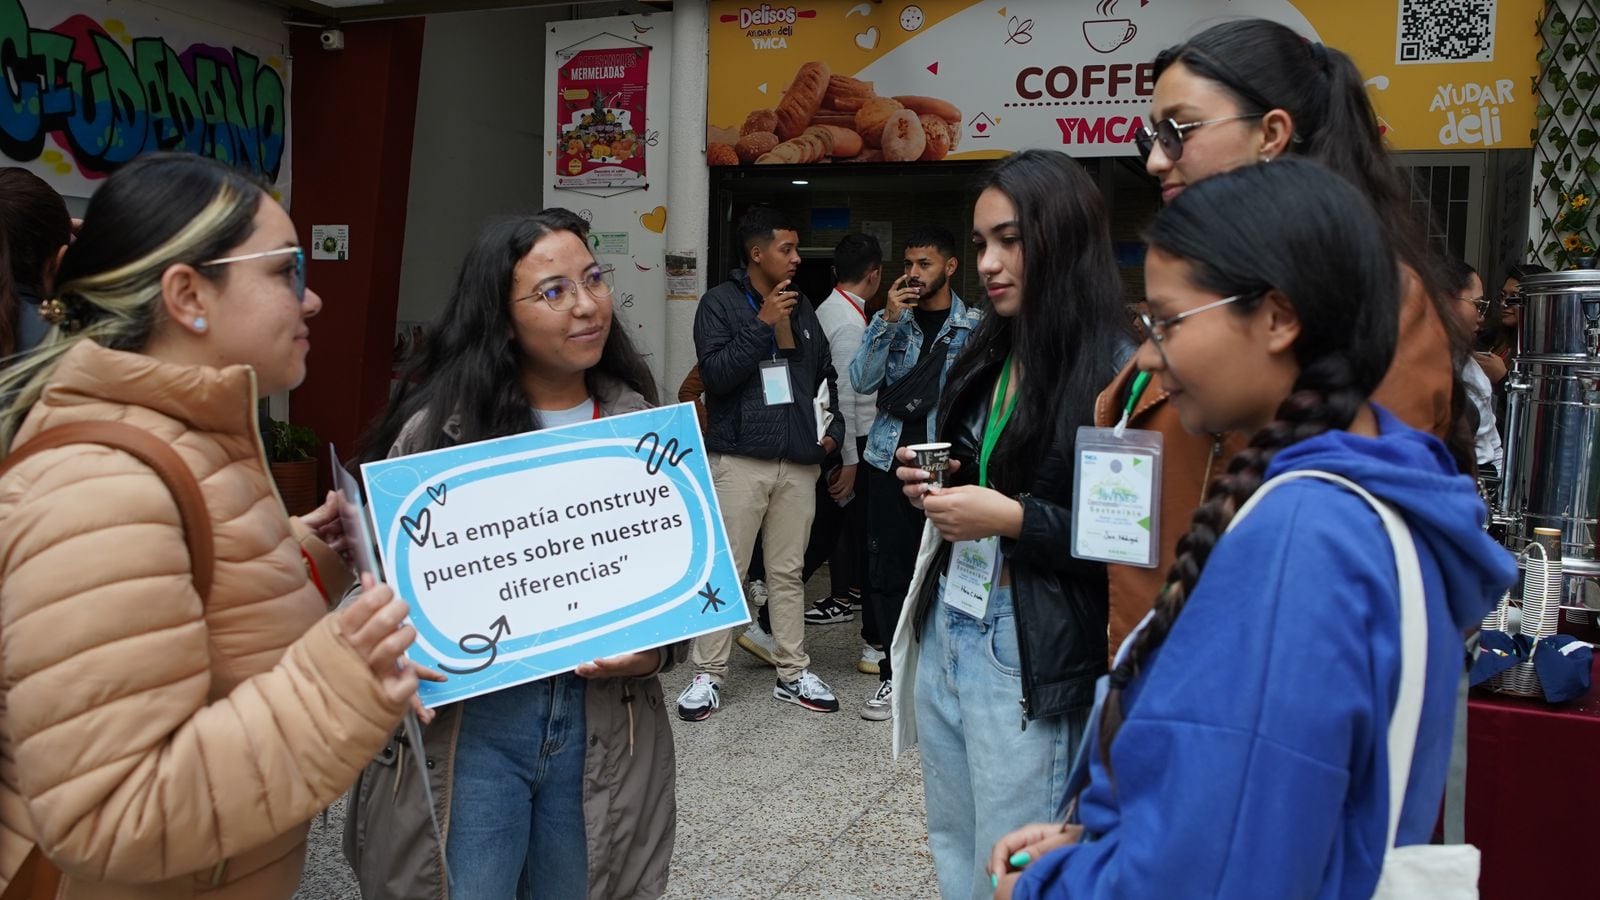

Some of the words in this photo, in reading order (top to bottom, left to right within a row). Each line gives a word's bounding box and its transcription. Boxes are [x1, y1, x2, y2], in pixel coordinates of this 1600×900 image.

[740, 3, 796, 29] Delisos
[752, 38, 787, 50] YMCA
[571, 65, 625, 80] MERMELADAS
[1015, 63, 1155, 99] COFFE
[1429, 79, 1515, 112] AYUDAR
[1056, 116, 1146, 144] YMCA
[1439, 106, 1502, 146] deli
[466, 507, 559, 539] empatía
[565, 485, 670, 519] construye
[424, 551, 518, 591] puentes
[524, 539, 585, 562] sobre
[591, 514, 683, 546] nuestras
